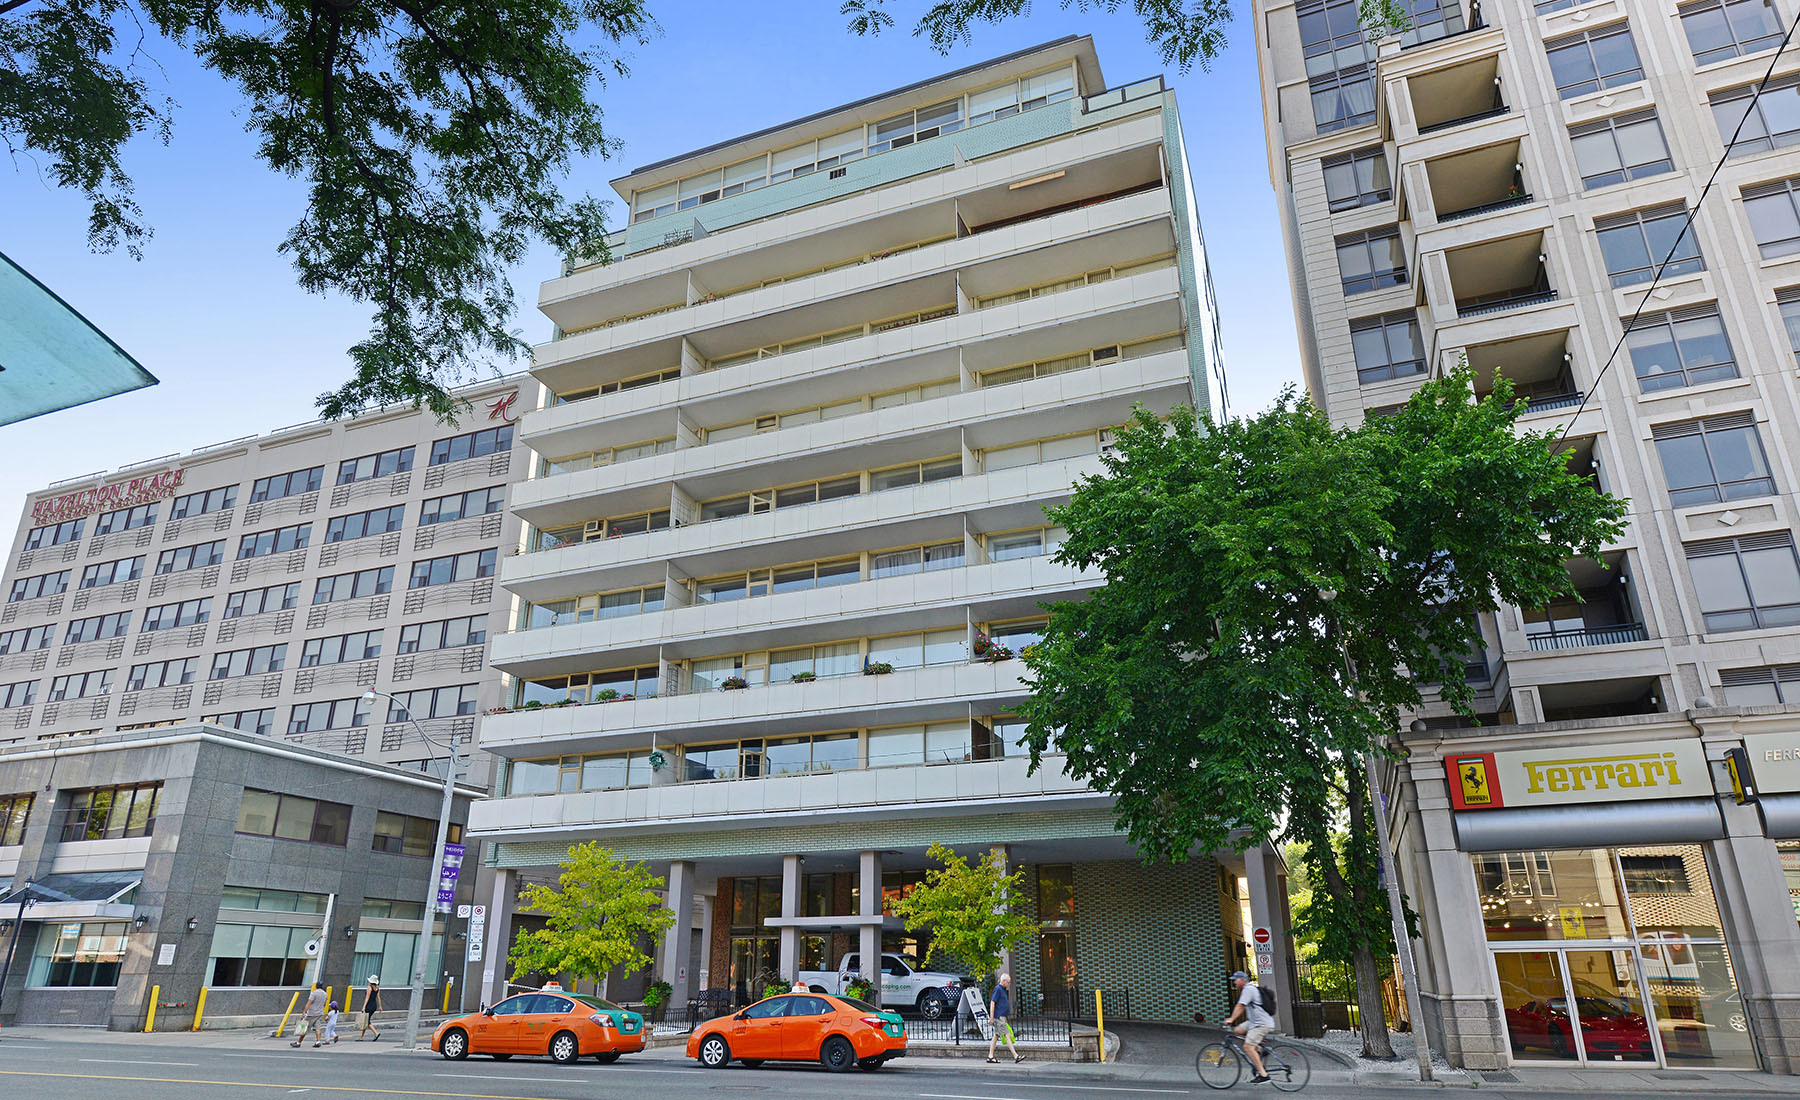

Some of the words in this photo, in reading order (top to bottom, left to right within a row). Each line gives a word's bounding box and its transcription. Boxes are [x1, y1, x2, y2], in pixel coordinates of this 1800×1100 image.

[31, 486, 121, 517] HAZELTON
[128, 469, 184, 495] PLACE
[1522, 752, 1682, 793] Ferrari
